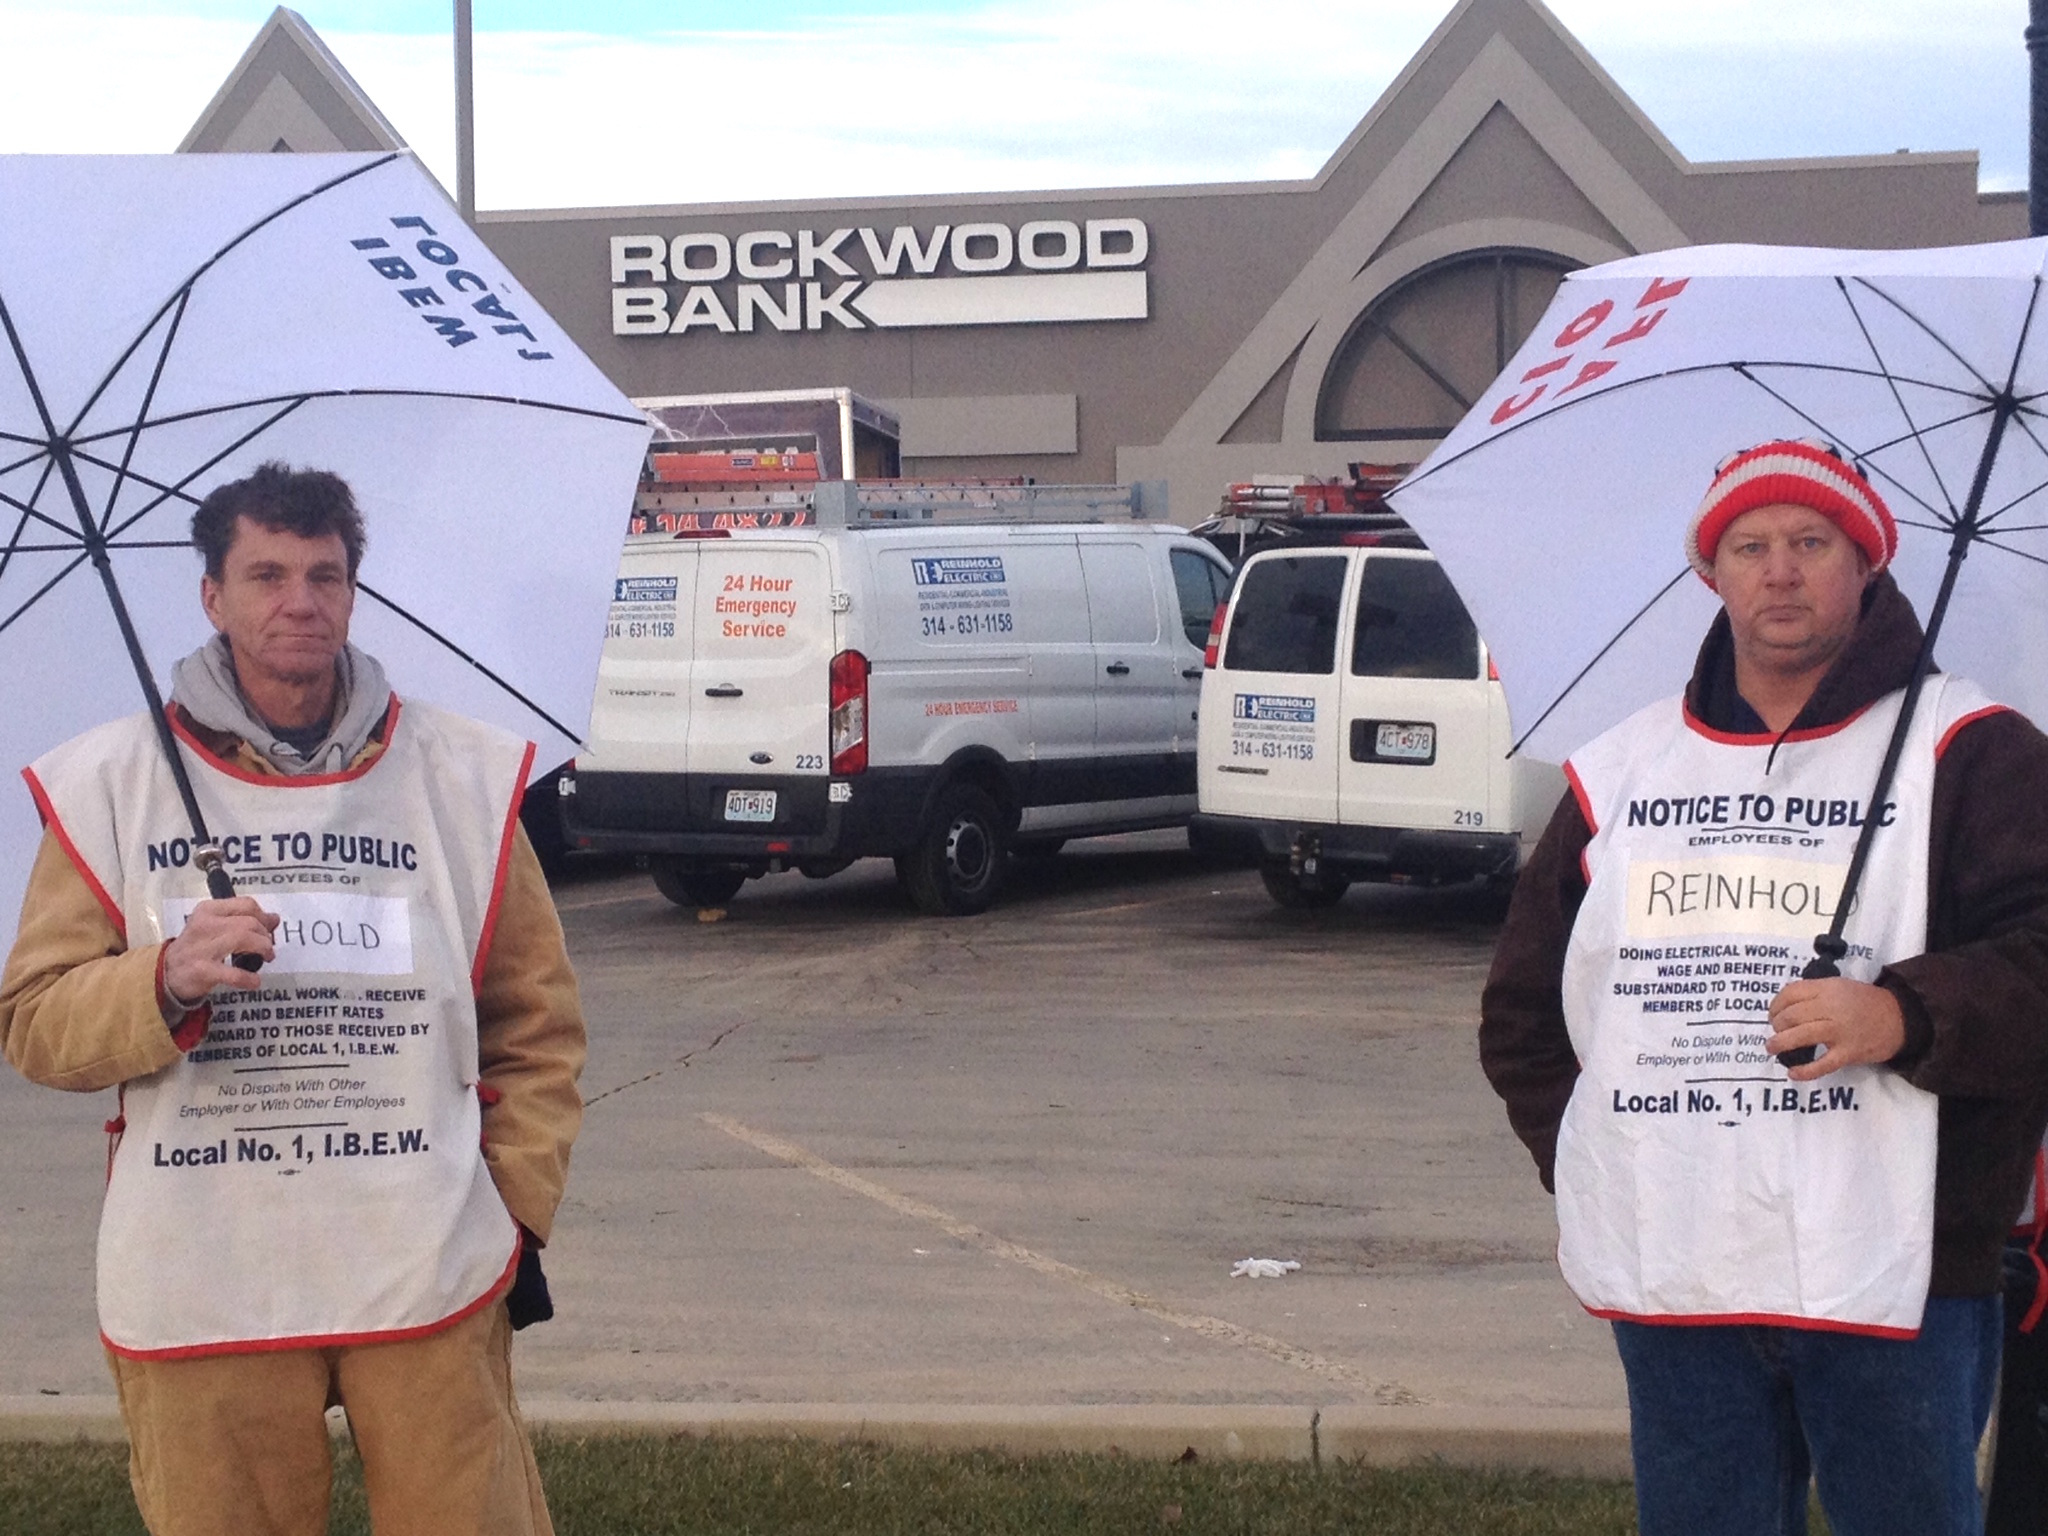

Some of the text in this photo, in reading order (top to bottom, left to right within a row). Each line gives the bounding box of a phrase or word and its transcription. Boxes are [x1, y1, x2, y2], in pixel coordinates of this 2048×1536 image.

[609, 217, 1149, 283] ROCKWOOD
[611, 279, 867, 336] BANK
[940, 559, 1001, 569] REINHOLD
[627, 578, 677, 589] REINHOLD
[723, 574, 793, 592] 24 Hour
[943, 572, 990, 583] ELECTRIC
[626, 590, 663, 600] ELECTRIC
[715, 597, 796, 618] Emergency
[629, 622, 675, 638] 631-1158
[722, 619, 786, 638] Service
[922, 616, 945, 637] 314
[957, 613, 1013, 635] 631-1158
[1258, 697, 1314, 708] REINHOLD
[1257, 710, 1299, 721] ELECTRIC
[1232, 739, 1252, 756] 314
[1262, 742, 1314, 761] 631-1158
[796, 754, 824, 769] 223
[1454, 810, 1484, 826] 219
[1627, 794, 1897, 827] NOTICE TO PUBLC
[1688, 833, 1825, 847] EMPLOYEES OF
[148, 831, 418, 871] NOCE TO PUBLIC
[230, 872, 361, 887] MPLOYEES OF
[1619, 944, 1790, 960] DOING ELECTRICAL WORK
[1657, 964, 1692, 978] WAGE
[1695, 963, 1721, 976] AND
[1723, 962, 1787, 977] BENEFIT
[1613, 981, 1707, 995] SUBSTANDARD
[1711, 979, 1726, 993] TO
[1730, 980, 1781, 994] THOSE
[208, 987, 426, 1005] LECTRICAL WORK RECEIVE
[1642, 997, 1770, 1014] MEMBERS OF LOCAL
[211, 1005, 385, 1023] GE AND BENEFIT RATES
[261, 1026, 281, 1039] TO
[285, 1024, 334, 1038] THOSE
[338, 1024, 406, 1038] RECEIVED
[410, 1023, 430, 1036] BY
[1671, 1033, 1767, 1049] No Dispute With
[256, 1044, 276, 1058] OF
[279, 1042, 328, 1058] LOCAL
[332, 1042, 345, 1057] 1,
[349, 1042, 400, 1056] I.B.E.W.
[1636, 1054, 1692, 1069] Employer
[1693, 1054, 1704, 1066] or
[1704, 1051, 1731, 1065] With
[1734, 1050, 1771, 1065] Other
[217, 1078, 367, 1098] No Dispute With Other
[179, 1095, 406, 1119] Employer or With Other Employees
[1613, 1086, 1859, 1116] Local No. 1, I.B.E.W.
[154, 1128, 430, 1167] Local No. 1, I.B.E.W.
